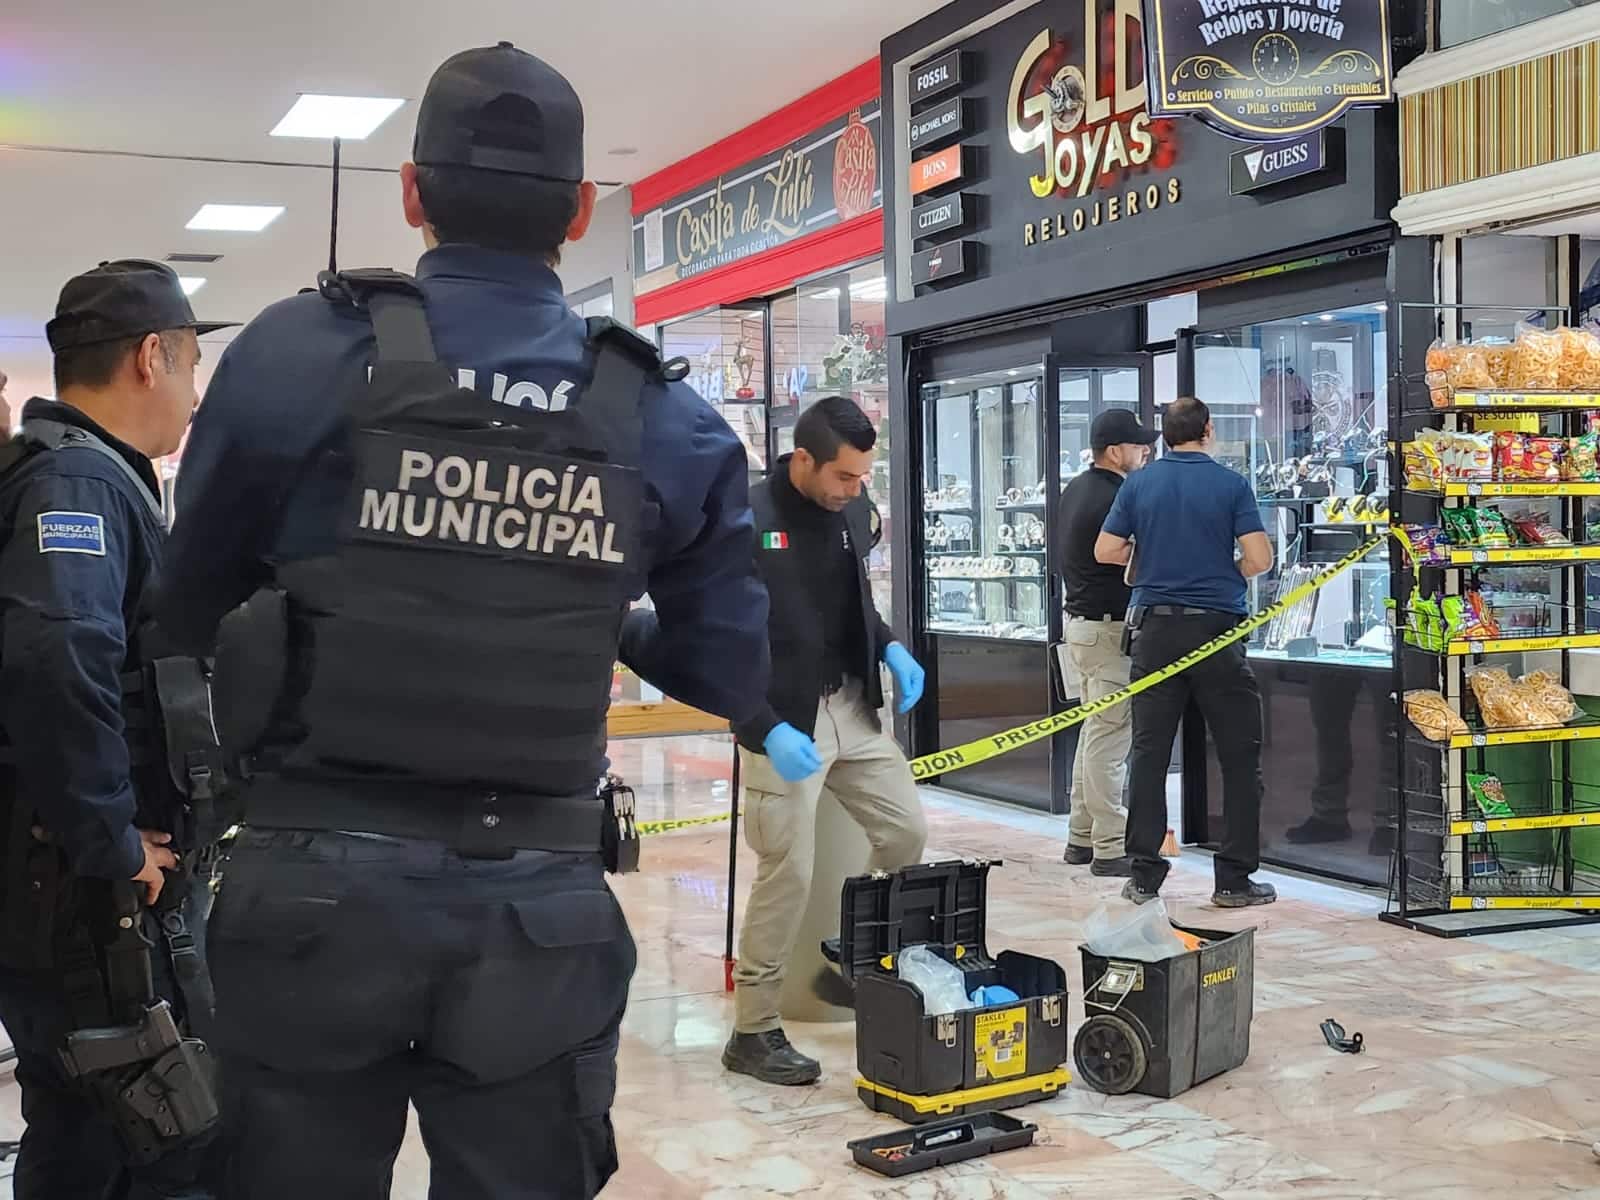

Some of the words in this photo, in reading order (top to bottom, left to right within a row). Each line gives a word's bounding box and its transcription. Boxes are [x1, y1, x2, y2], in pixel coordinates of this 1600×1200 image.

[1198, 9, 1264, 46] Relojes
[1267, 8, 1278, 31] y
[1282, 6, 1344, 41] Joyería
[917, 65, 949, 92] FOSSIL
[1177, 88, 1213, 102] Servicio
[1224, 87, 1254, 100] Pulido
[1264, 84, 1323, 97] Restauración
[1333, 82, 1381, 95] Extensibles
[1247, 102, 1269, 114] Pilas
[1281, 101, 1317, 113] Cristales
[1029, 111, 1153, 198] JOYAS
[1262, 142, 1308, 173] GUESS
[922, 158, 946, 180] BOSS
[676, 176, 735, 266] Casita
[741, 185, 760, 235] de
[761, 149, 815, 237] Lulú
[918, 204, 952, 229] CITIZEN
[1024, 177, 1181, 247] RELOJEROS
[398, 449, 604, 517] POLICÍA
[42, 523, 99, 534] FUERZAS
[359, 488, 625, 564] MUNICIPAL
[1203, 965, 1237, 988] STANLEY
[976, 1012, 1006, 1024] STANLEY
